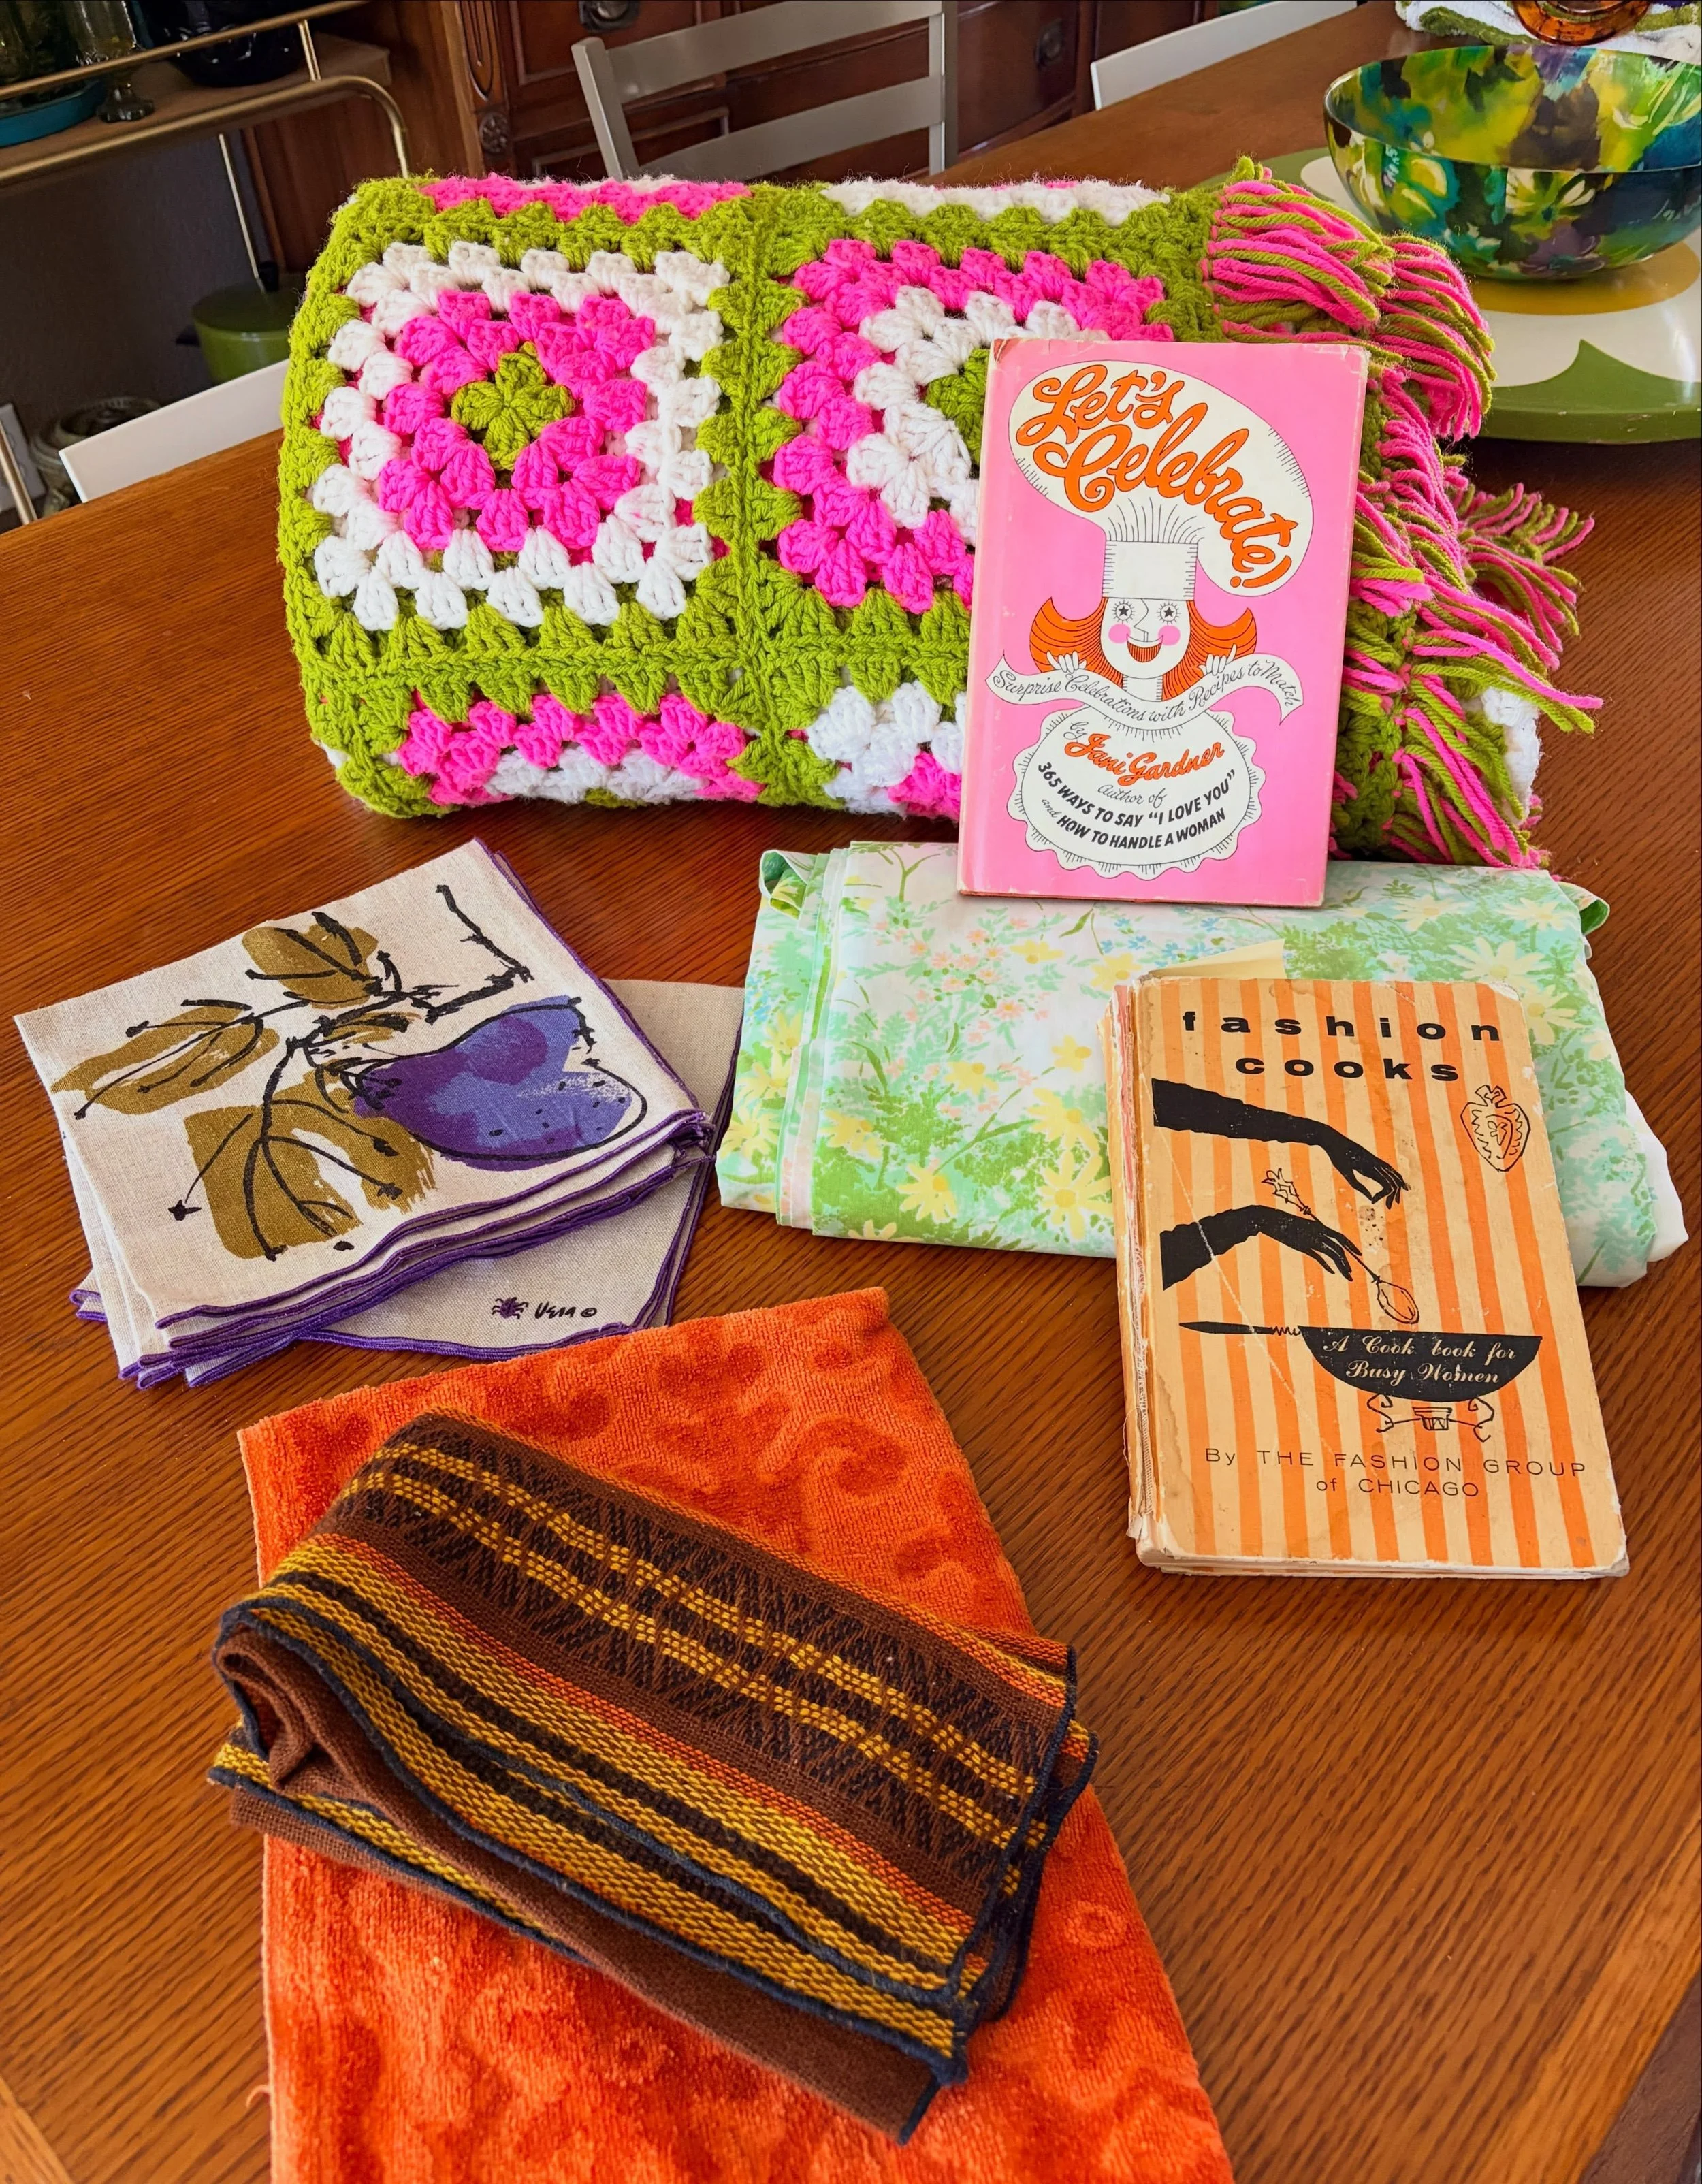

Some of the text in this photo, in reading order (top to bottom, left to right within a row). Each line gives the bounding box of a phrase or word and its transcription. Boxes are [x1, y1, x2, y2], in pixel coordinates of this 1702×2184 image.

[1016, 364, 1184, 445] Let's
[1033, 402, 1298, 588] Celebrate!
[993, 660, 1301, 722] Surprise Celebrations with Recipes to Match
[1063, 721, 1089, 743] by
[1064, 733, 1225, 786] Jani Gardner
[1038, 762, 1063, 787] 365
[1057, 785, 1095, 814] WAYS
[1095, 807, 1114, 823] TO
[1114, 813, 1144, 828] SAY
[1168, 797, 1202, 822] LOVE
[1097, 784, 1167, 809] Author of
[1042, 799, 1225, 849] and HOW TO HANDLE A WOMAN
[1182, 1010, 1500, 1042] fashion
[1235, 1057, 1458, 1082] cooks
[1323, 1335, 1515, 1366] A Cook book for
[1346, 1360, 1499, 1386] Busy Women
[1206, 1448, 1585, 1476] By THE FASHION GROUP
[1317, 1478, 1479, 1496] of CHICAGO
